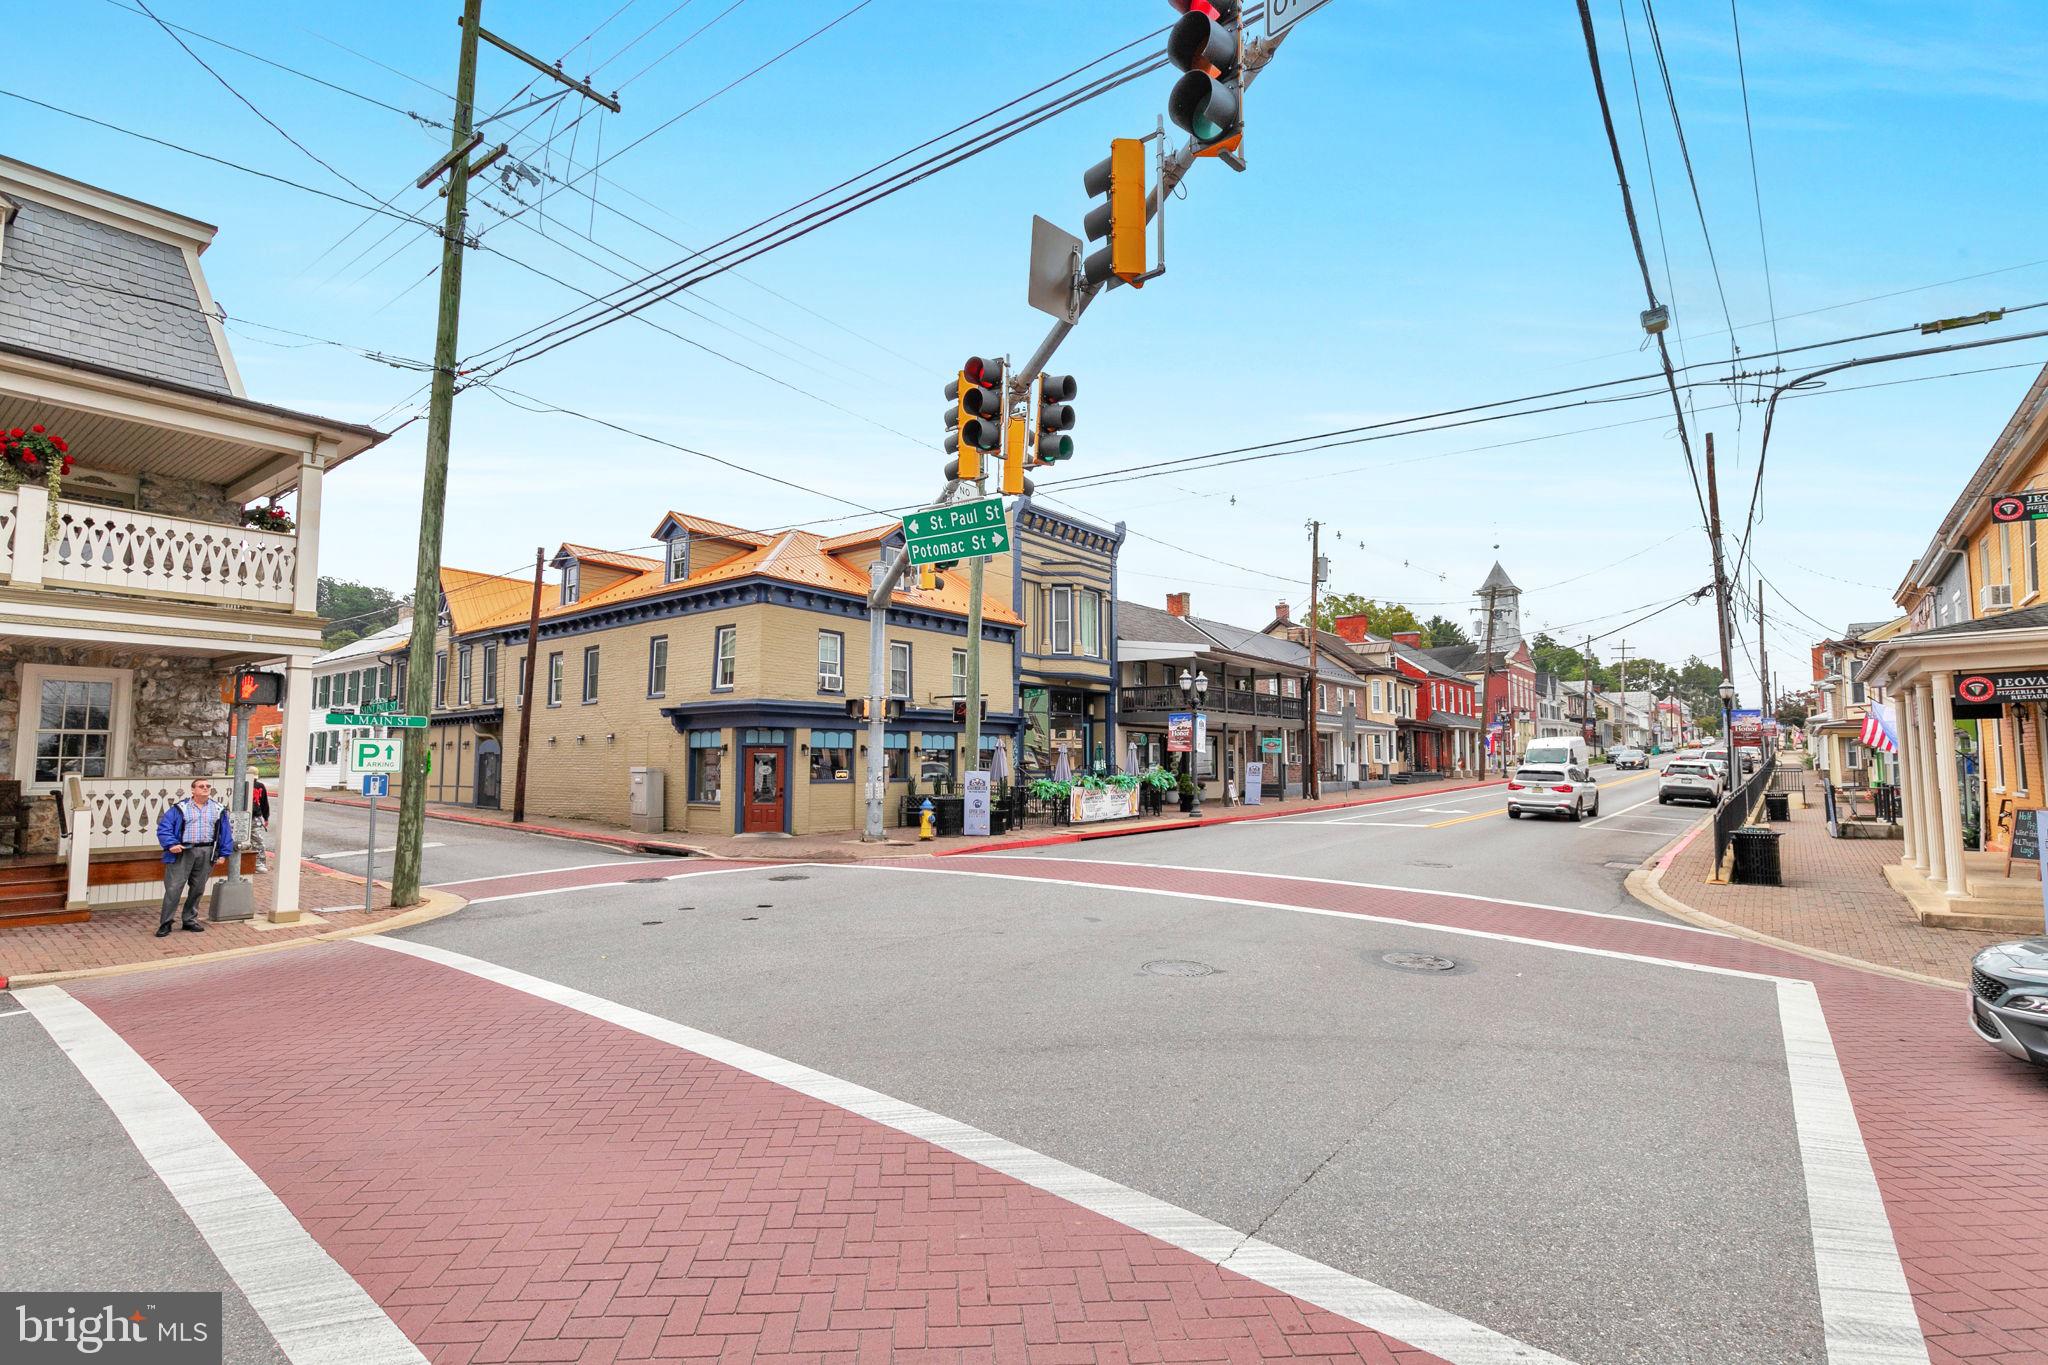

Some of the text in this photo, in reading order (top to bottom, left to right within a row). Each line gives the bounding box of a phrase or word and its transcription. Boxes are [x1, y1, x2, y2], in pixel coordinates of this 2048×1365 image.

[960, 486, 971, 497] NO
[930, 504, 1000, 530] St. Paul St
[911, 535, 987, 559] Potomac St
[1996, 676, 2048, 688] JEOVA
[344, 716, 411, 726] N MAIN ST
